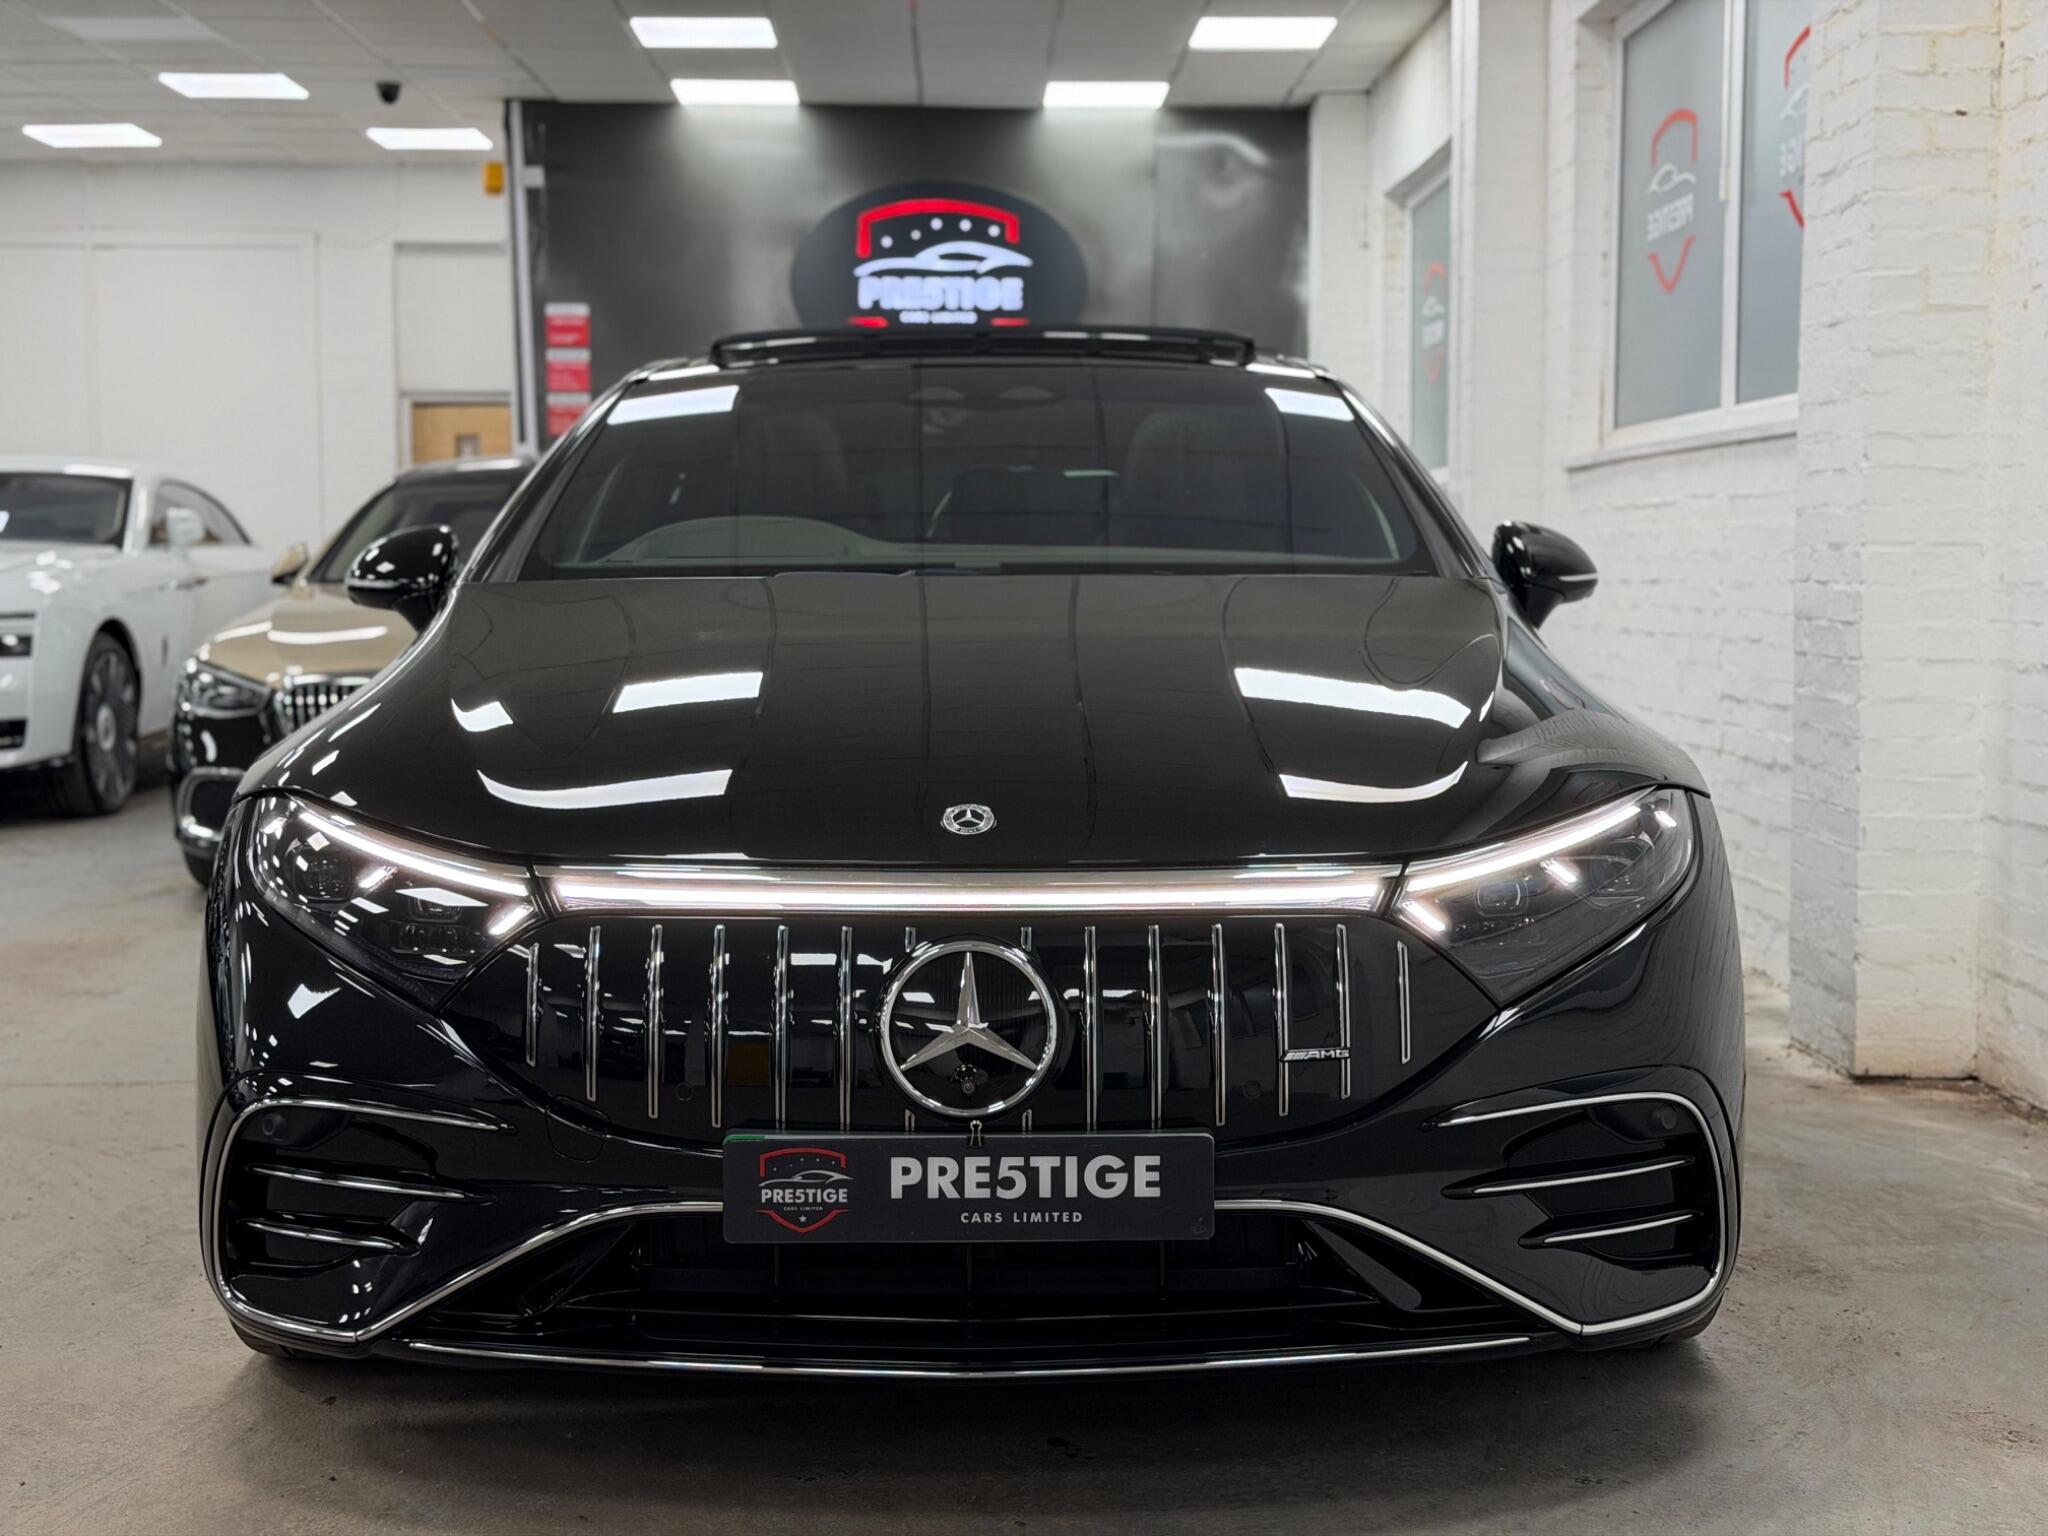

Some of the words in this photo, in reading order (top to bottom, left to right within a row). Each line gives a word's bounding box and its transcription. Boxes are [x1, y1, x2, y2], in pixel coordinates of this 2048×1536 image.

[1304, 1049, 1349, 1060] AMG
[890, 1154, 1161, 1200] PRE5TIGE
[761, 1188, 848, 1204] PRE5TIGE
[960, 1212, 1003, 1223] CARS
[1013, 1211, 1083, 1223] LIMITED
